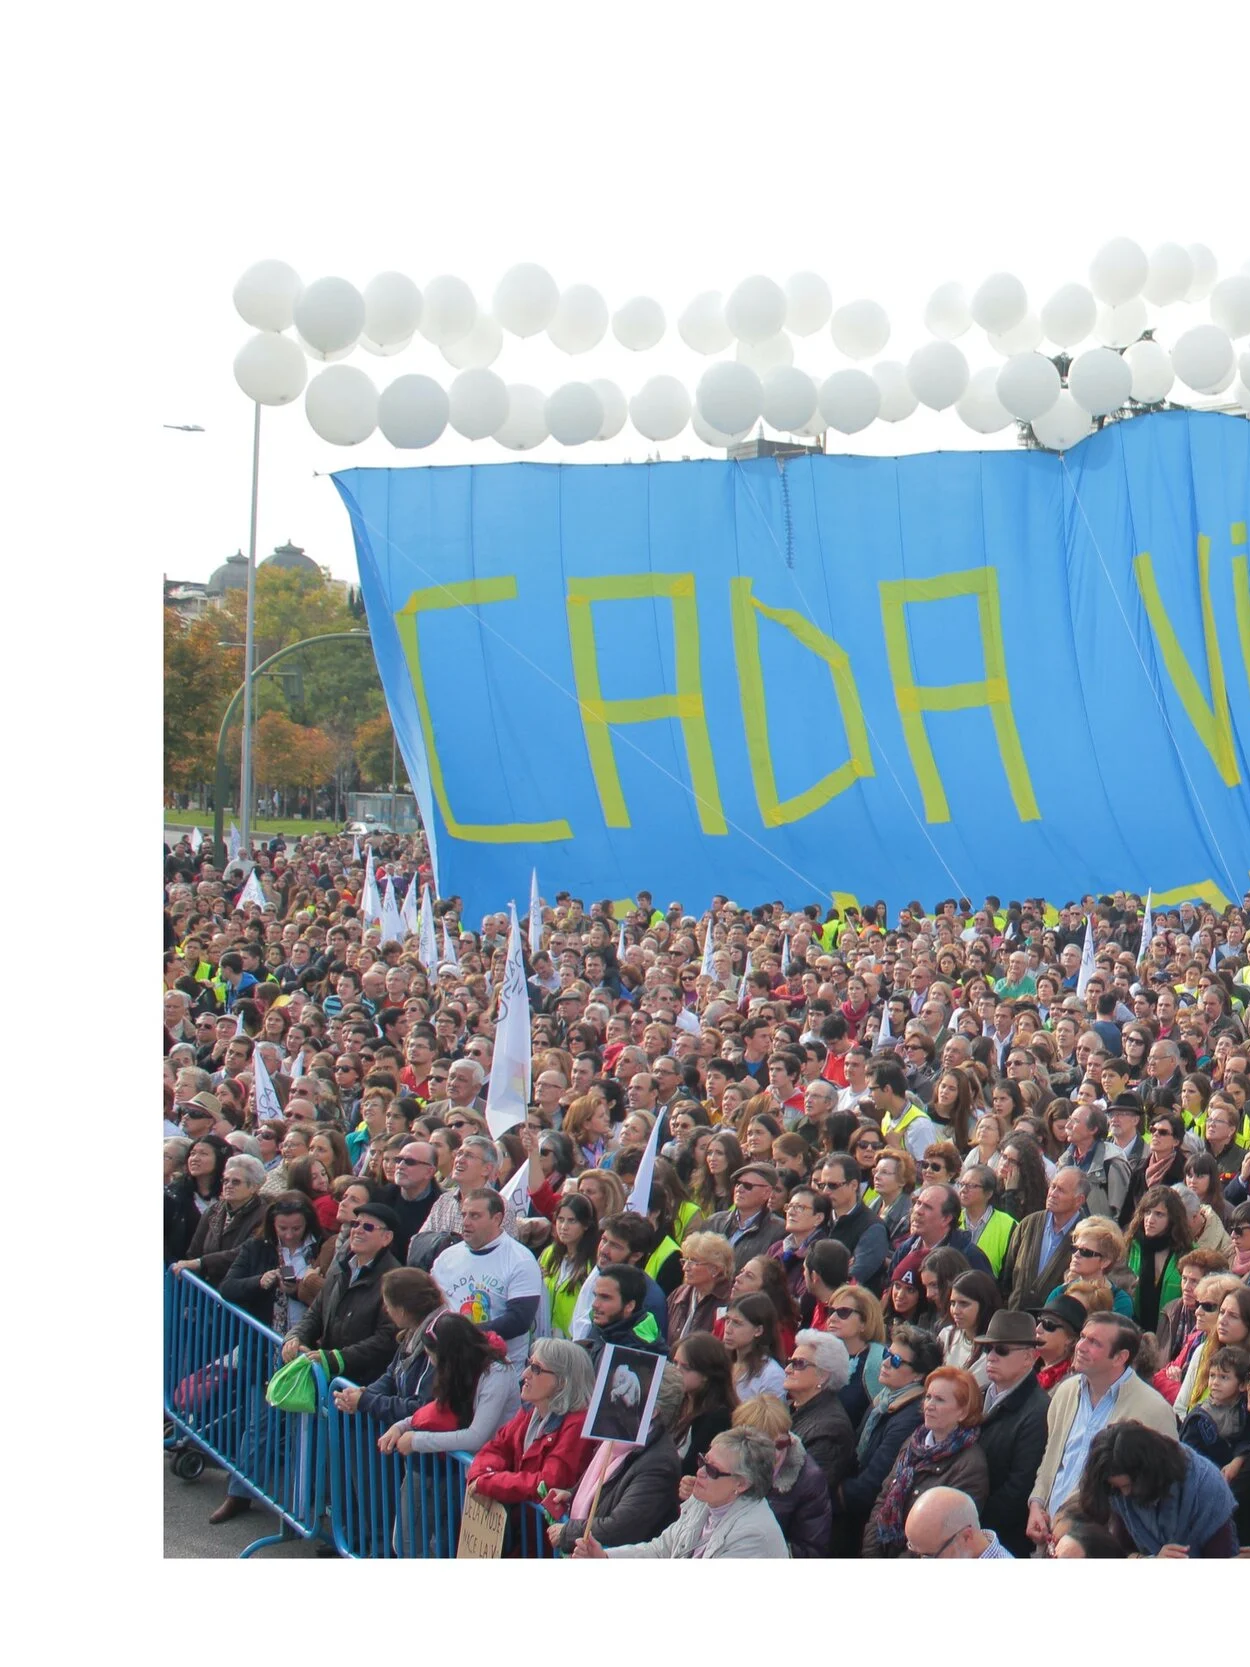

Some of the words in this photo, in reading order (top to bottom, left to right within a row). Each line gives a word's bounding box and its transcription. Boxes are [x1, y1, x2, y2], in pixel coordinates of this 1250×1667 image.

[393, 566, 1042, 843] CADA
[446, 1275, 475, 1297] CADA
[482, 1274, 505, 1294] VIDA
[901, 1270, 913, 1284] A
